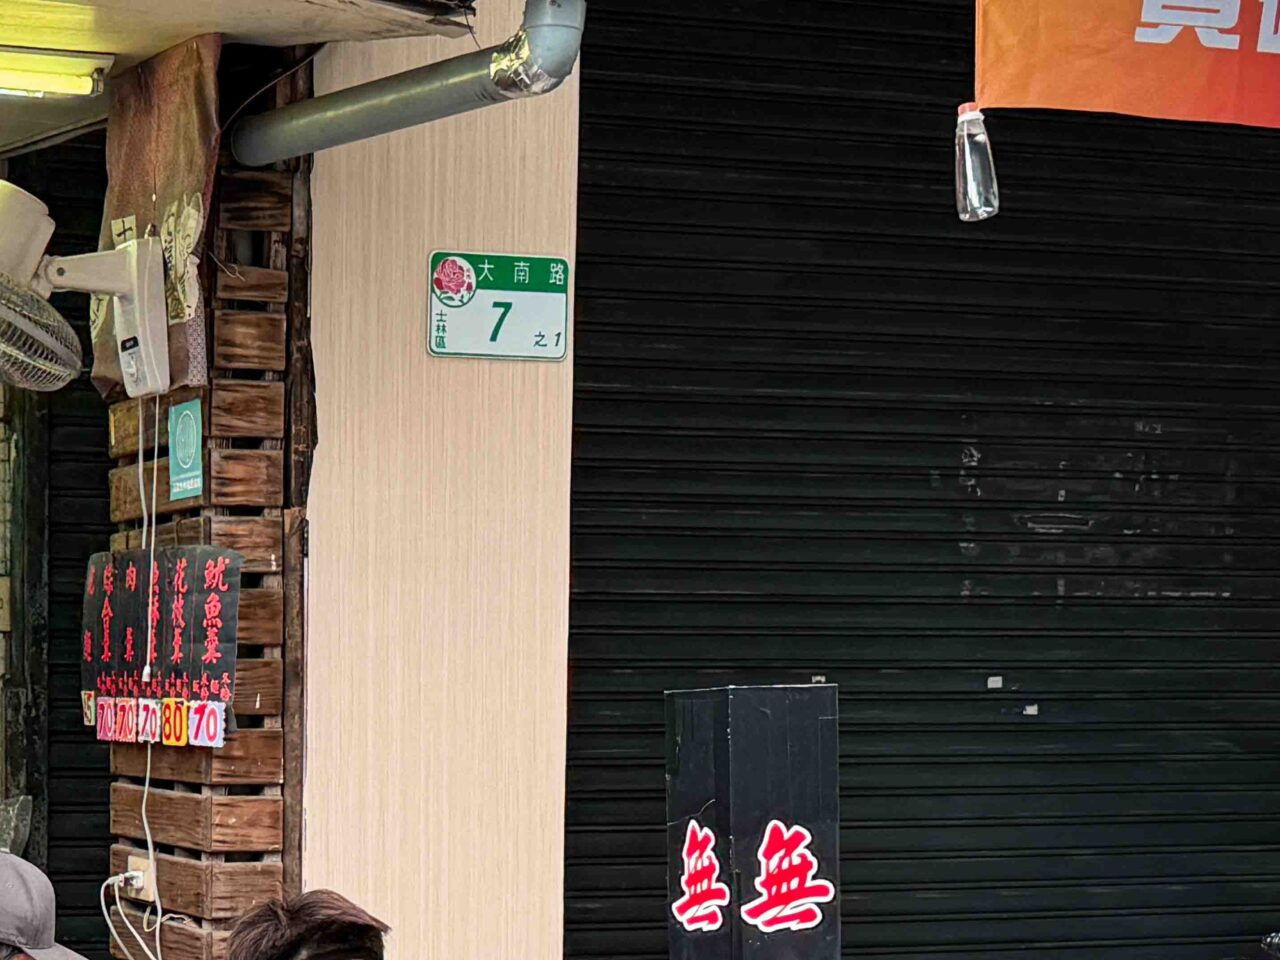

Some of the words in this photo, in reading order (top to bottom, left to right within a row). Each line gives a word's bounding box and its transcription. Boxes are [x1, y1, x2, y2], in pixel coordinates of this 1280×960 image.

[477, 259, 566, 286] 大南路
[434, 310, 448, 349] 士林區
[488, 301, 513, 342] 7
[201, 555, 231, 665] 魷魚羹
[116, 704, 135, 740] 70
[139, 704, 158, 741] 70
[161, 702, 183, 742] 80
[192, 702, 219, 742] 70
